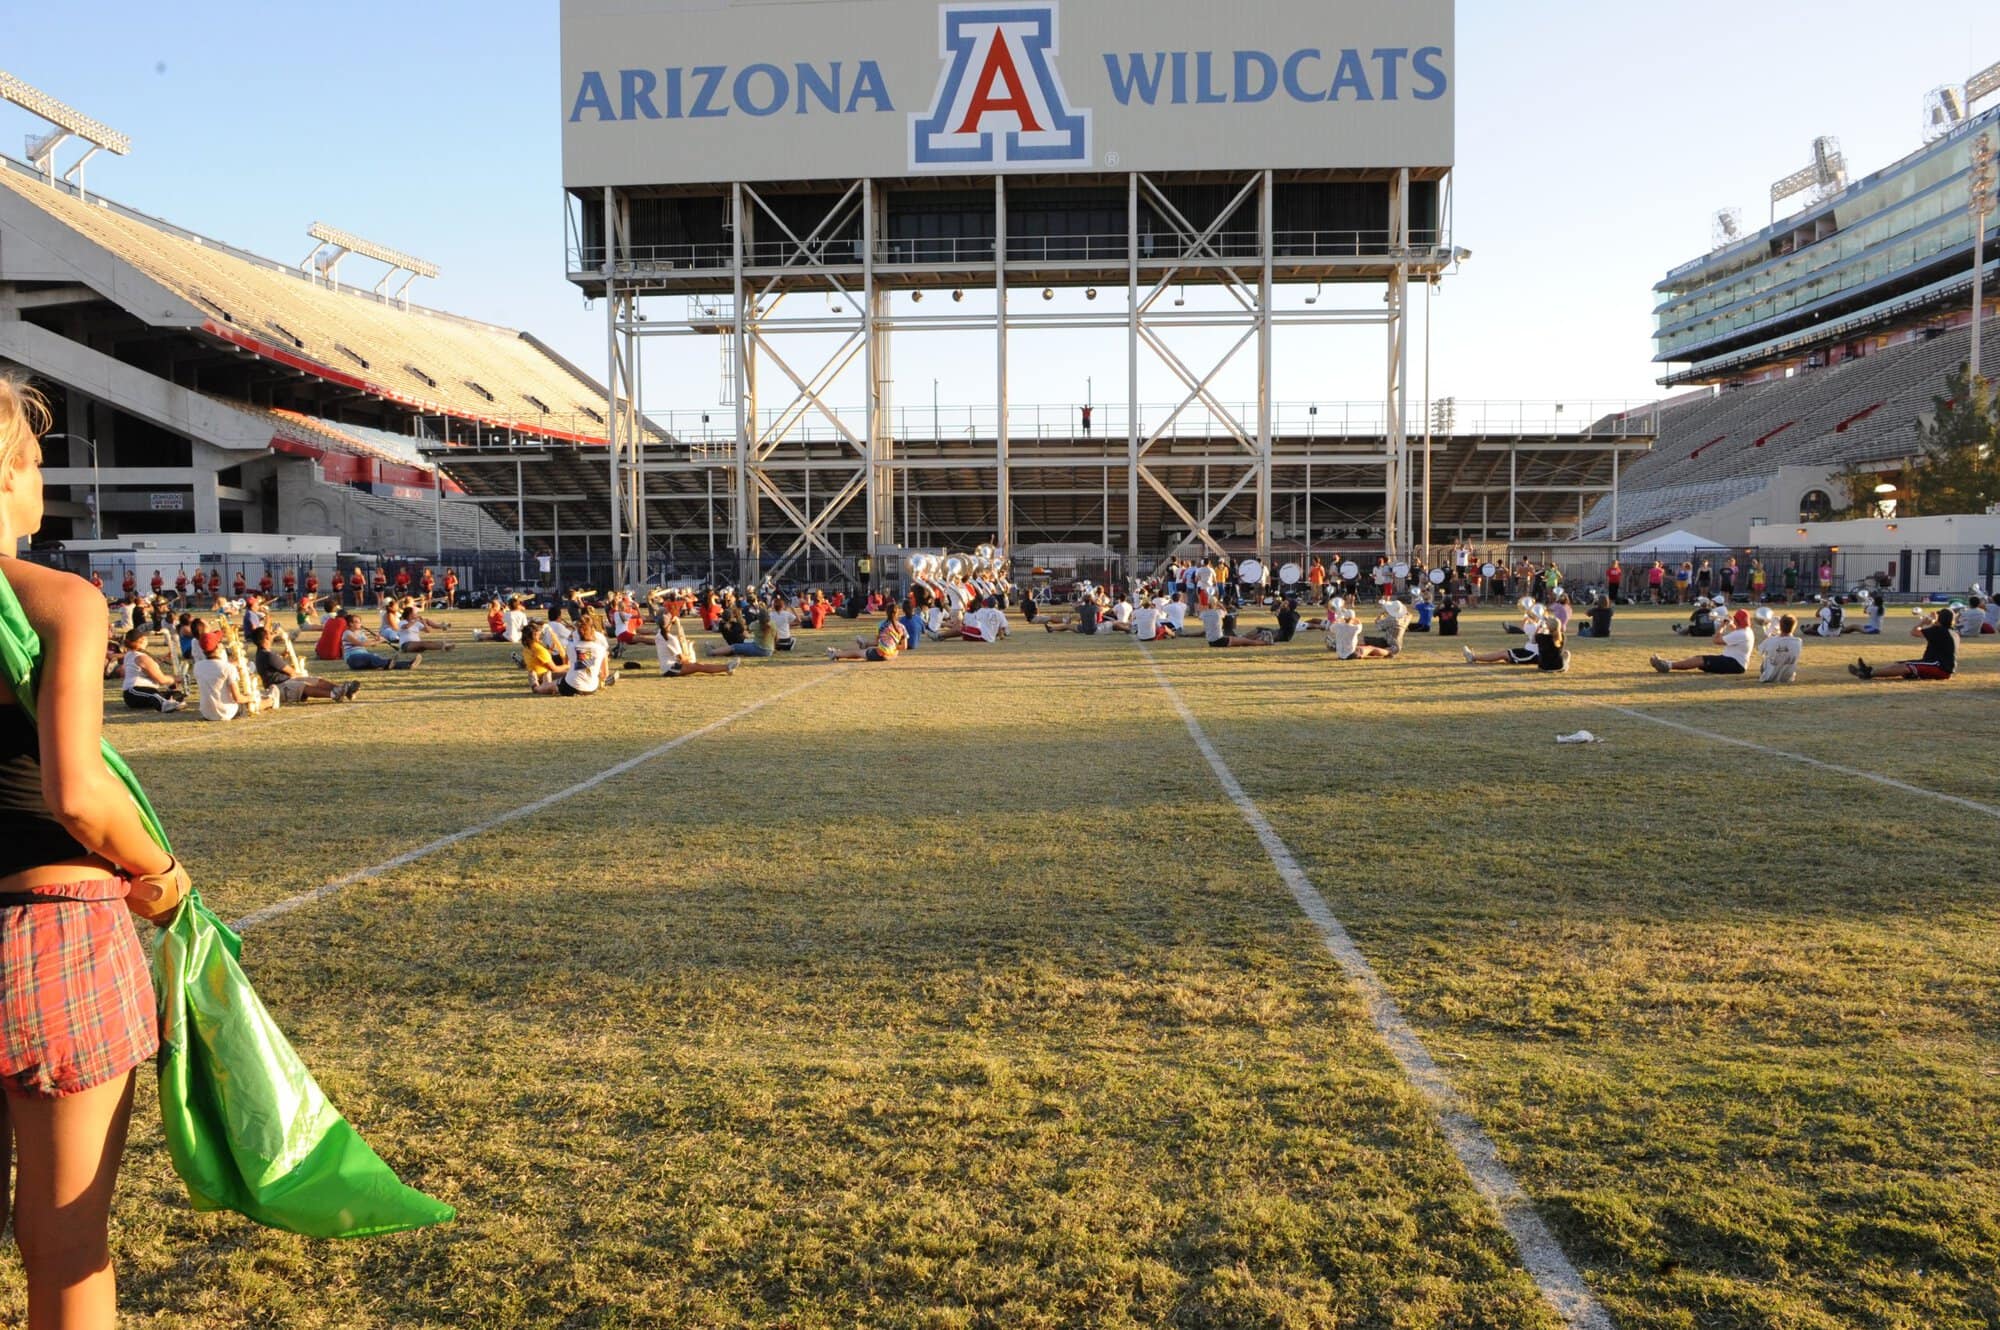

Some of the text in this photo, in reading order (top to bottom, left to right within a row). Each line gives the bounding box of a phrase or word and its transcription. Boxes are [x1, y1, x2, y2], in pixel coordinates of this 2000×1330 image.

[569, 61, 894, 122] ARIZONA
[907, 4, 1092, 172] A
[1102, 46, 1448, 106] WILDCATS
